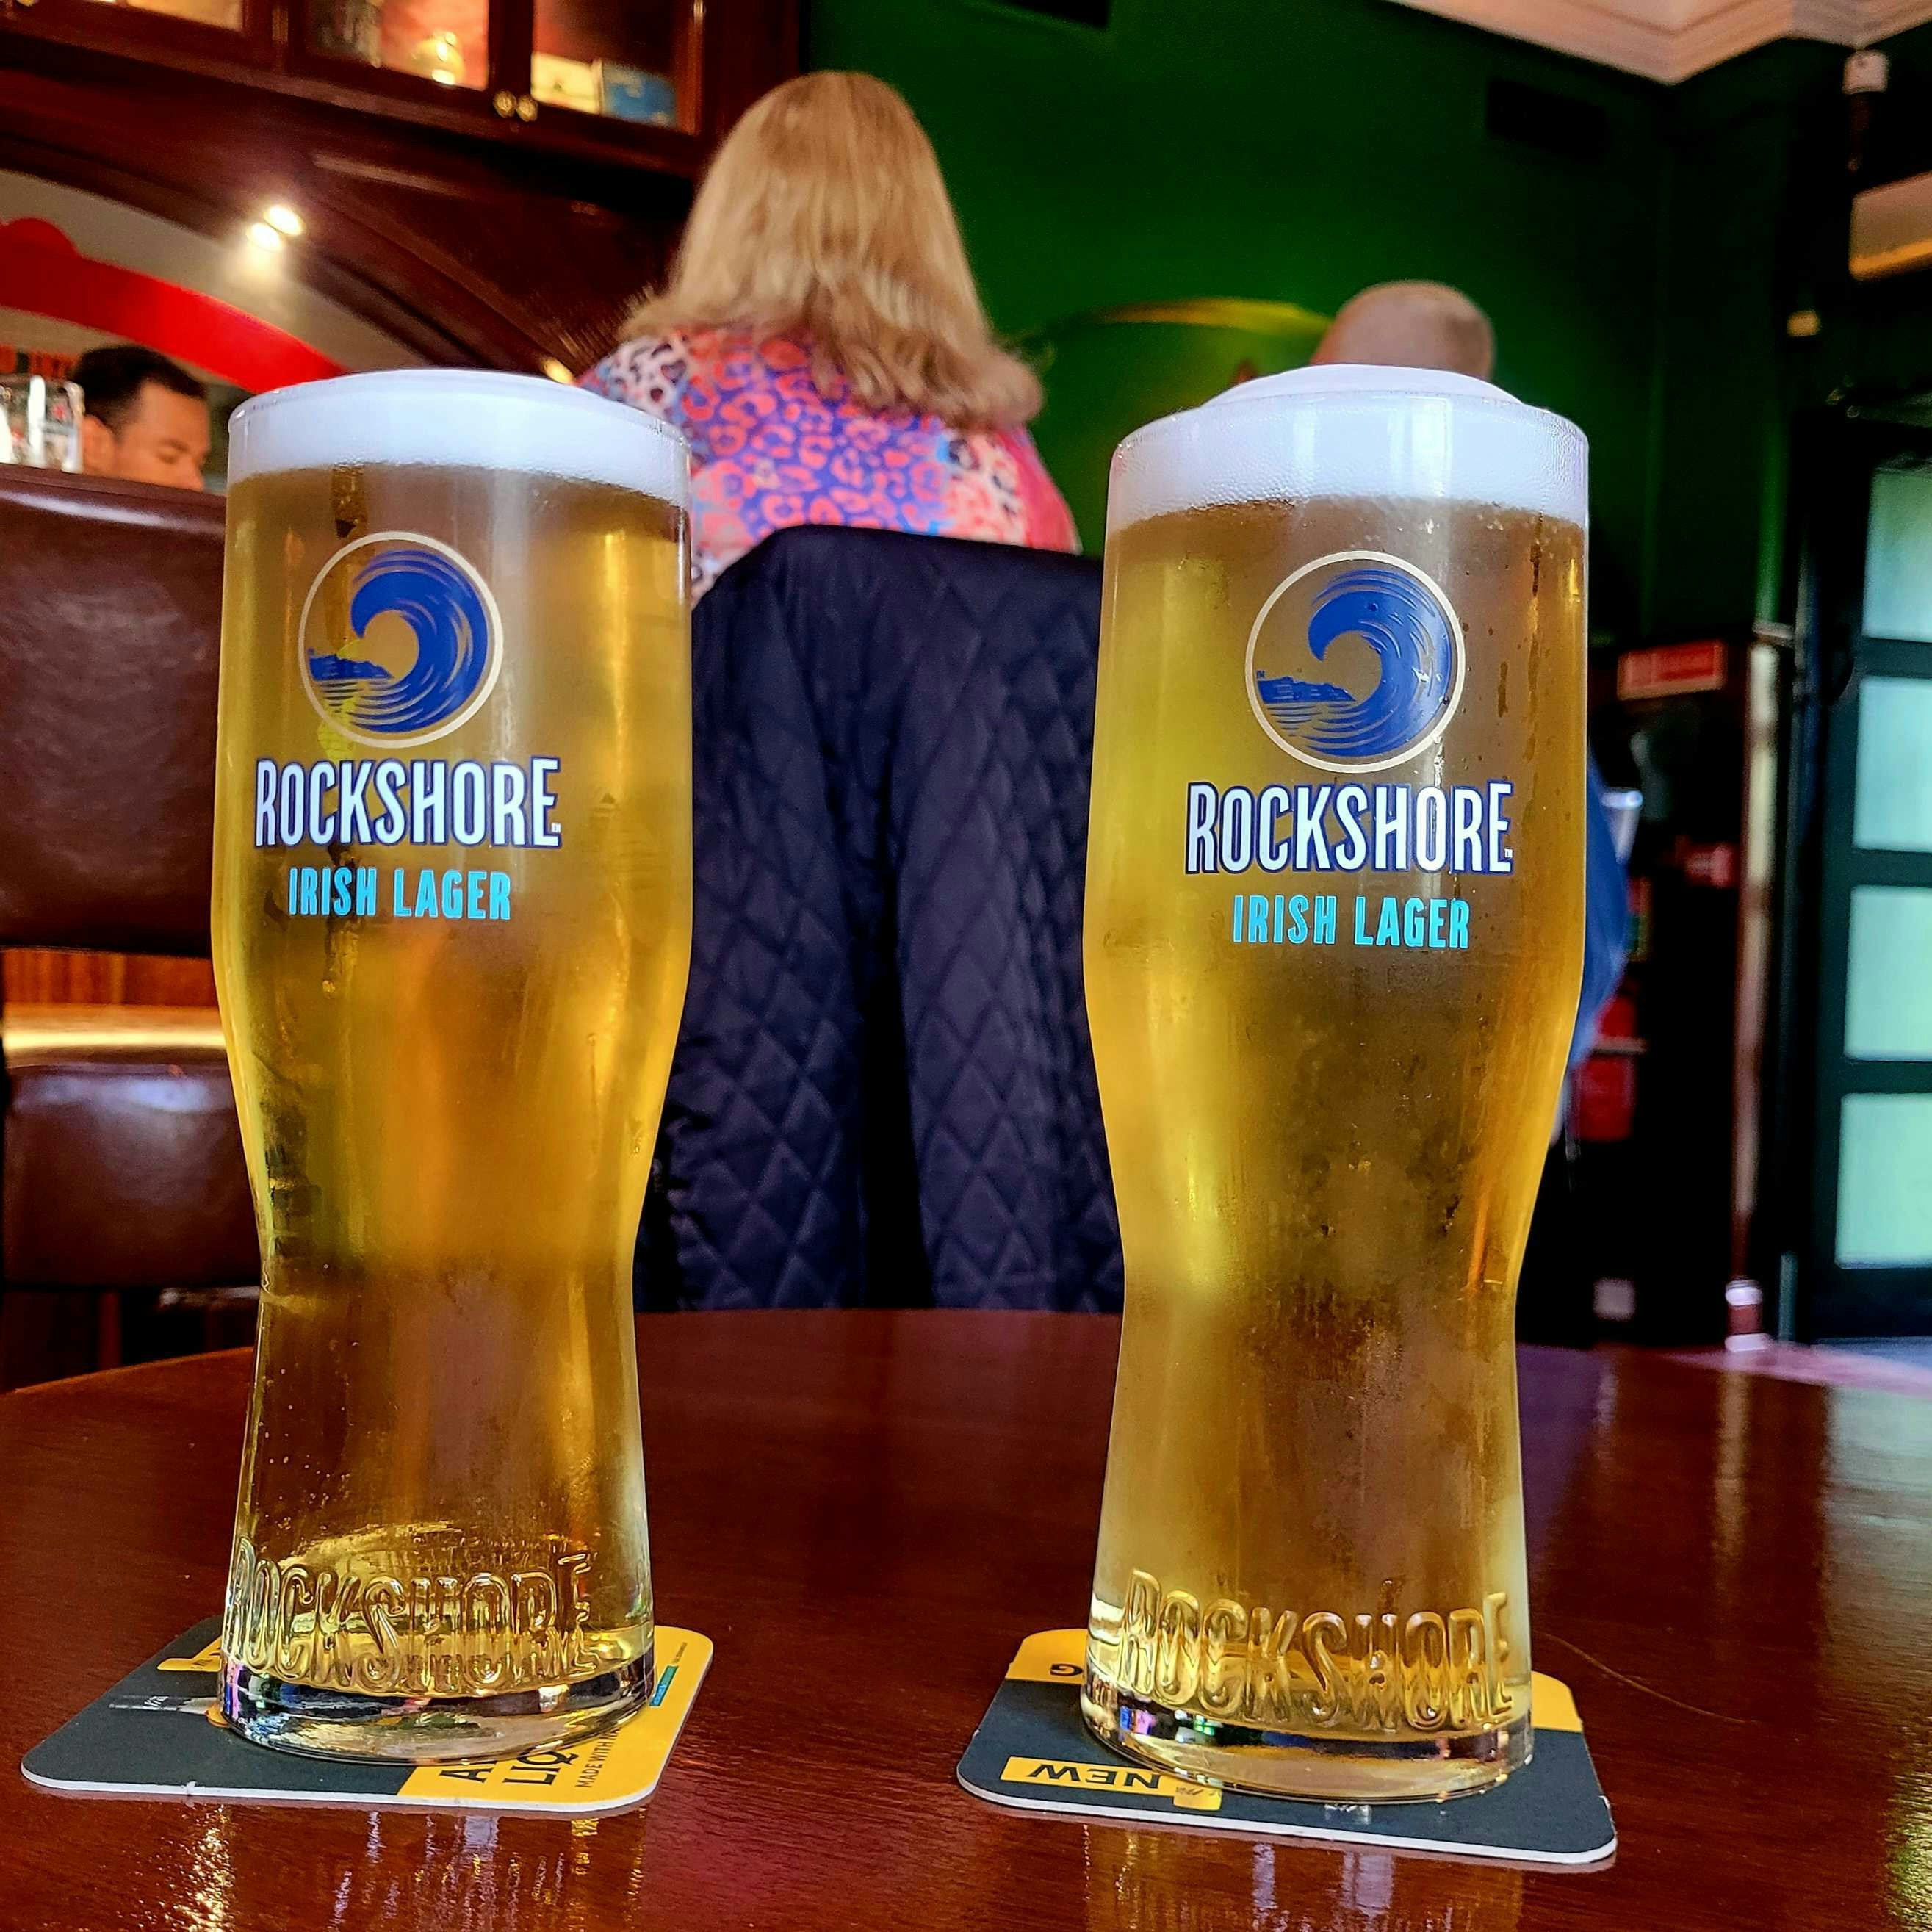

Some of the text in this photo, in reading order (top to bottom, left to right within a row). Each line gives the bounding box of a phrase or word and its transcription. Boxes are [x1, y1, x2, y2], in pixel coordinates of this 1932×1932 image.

[254, 756, 563, 848] ROCKSHORE
[1186, 780, 1513, 875] ROCKSHORE
[287, 865, 512, 920] IRISH LAGER
[1233, 895, 1470, 949] IRISH LAGER
[1117, 1568, 1514, 1733] ROCKSHORE
[574, 1763, 603, 1788] MADE
[587, 1741, 615, 1762] WITH
[1027, 1764, 1161, 1789] NEW
